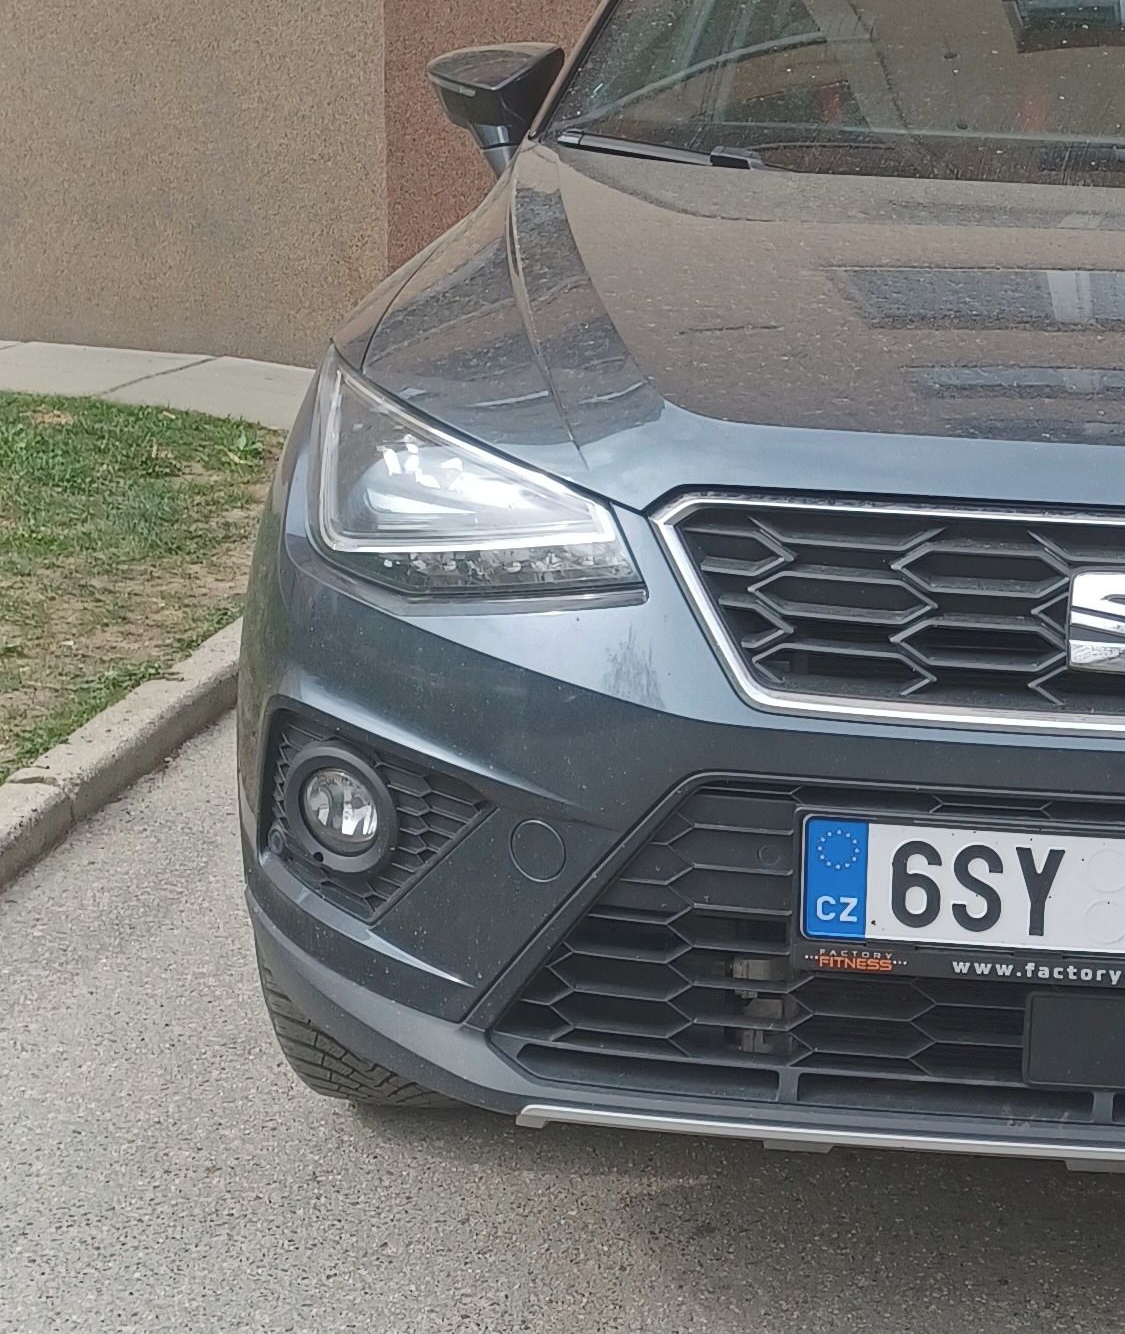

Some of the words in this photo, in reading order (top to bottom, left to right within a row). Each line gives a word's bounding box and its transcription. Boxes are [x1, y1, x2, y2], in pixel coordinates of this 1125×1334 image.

[891, 840, 1066, 936] 6SY
[816, 895, 858, 922] CZ
[819, 948, 893, 959] FACTORY
[819, 956, 893, 971] FITNESS
